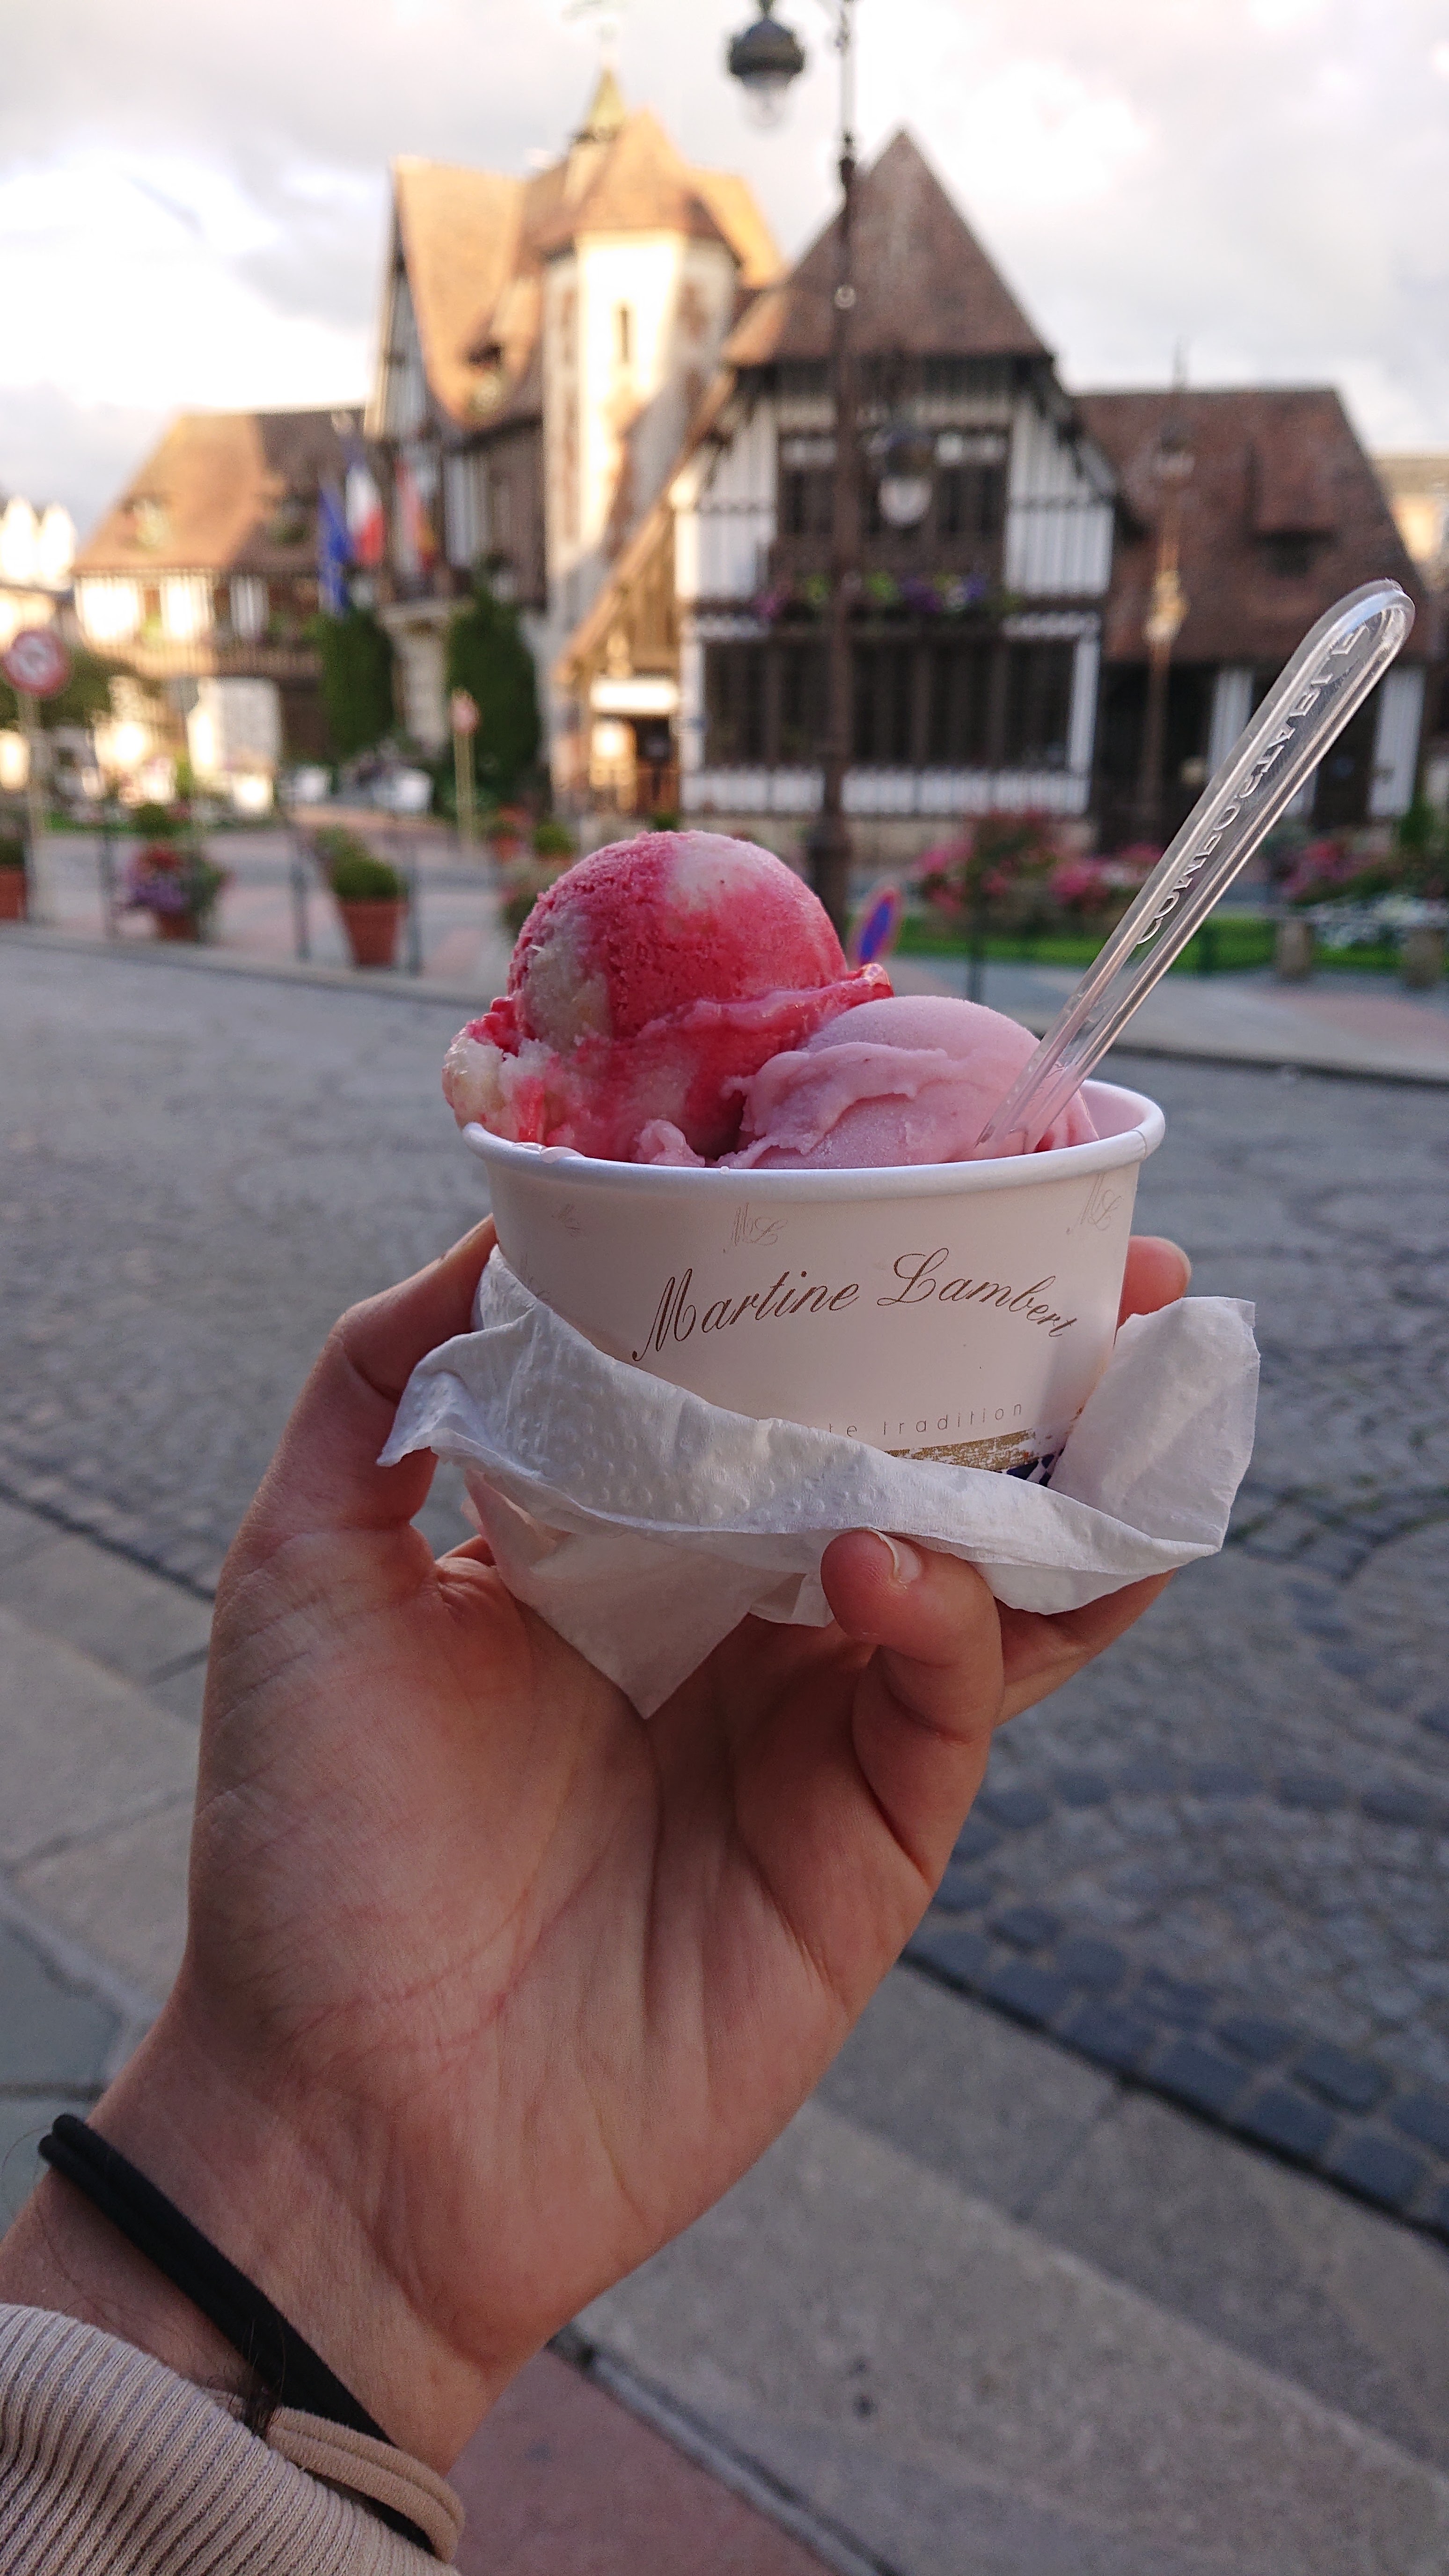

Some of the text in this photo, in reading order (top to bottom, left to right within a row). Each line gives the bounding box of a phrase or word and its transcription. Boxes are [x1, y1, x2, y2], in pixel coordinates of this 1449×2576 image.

[632, 1268, 860, 1361] Martine
[876, 1247, 1077, 1337] Lambert
[883, 1403, 1022, 1436] tradition
